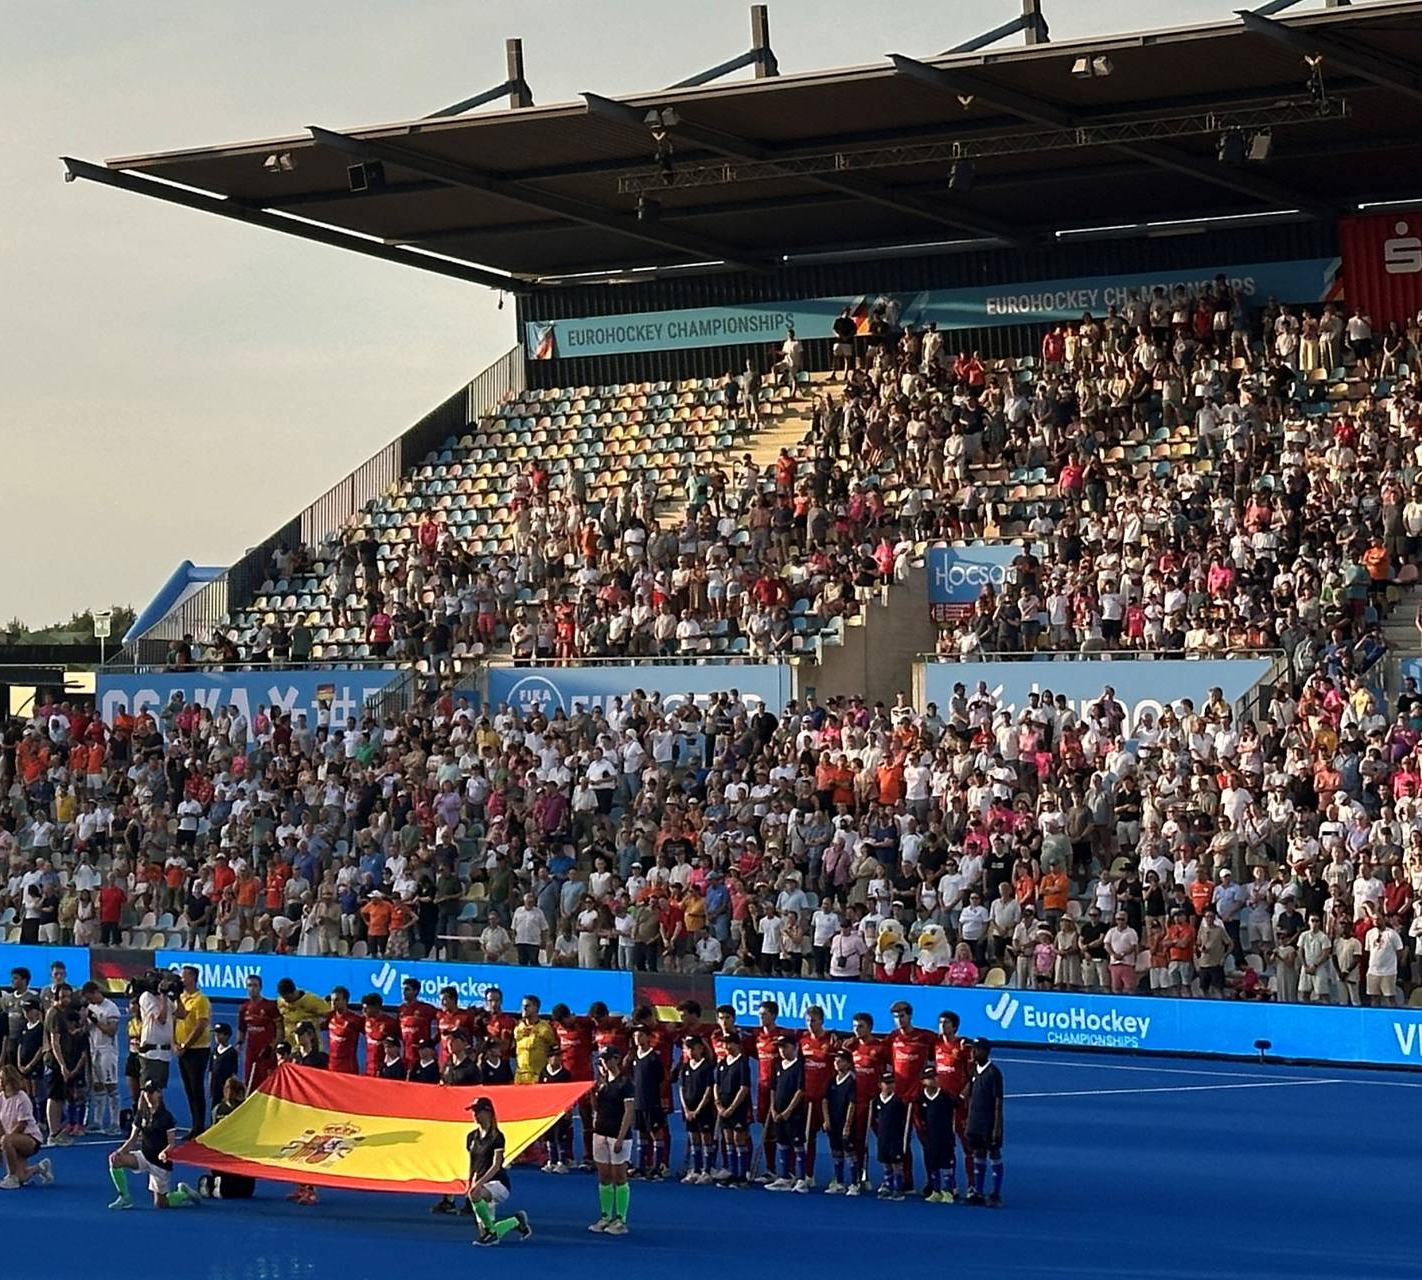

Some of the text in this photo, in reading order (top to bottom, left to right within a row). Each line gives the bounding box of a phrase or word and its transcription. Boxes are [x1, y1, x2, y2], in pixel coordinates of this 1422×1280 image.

[986, 288, 1099, 315] EUROHOCKEY
[567, 312, 796, 348] EUROHOCKEY CHAMPIONSHIPS
[519, 689, 552, 701] FIKA
[1023, 1005, 1150, 1039] EuroHockey
[1047, 1031, 1139, 1048] CHAMPIONSHIPS
